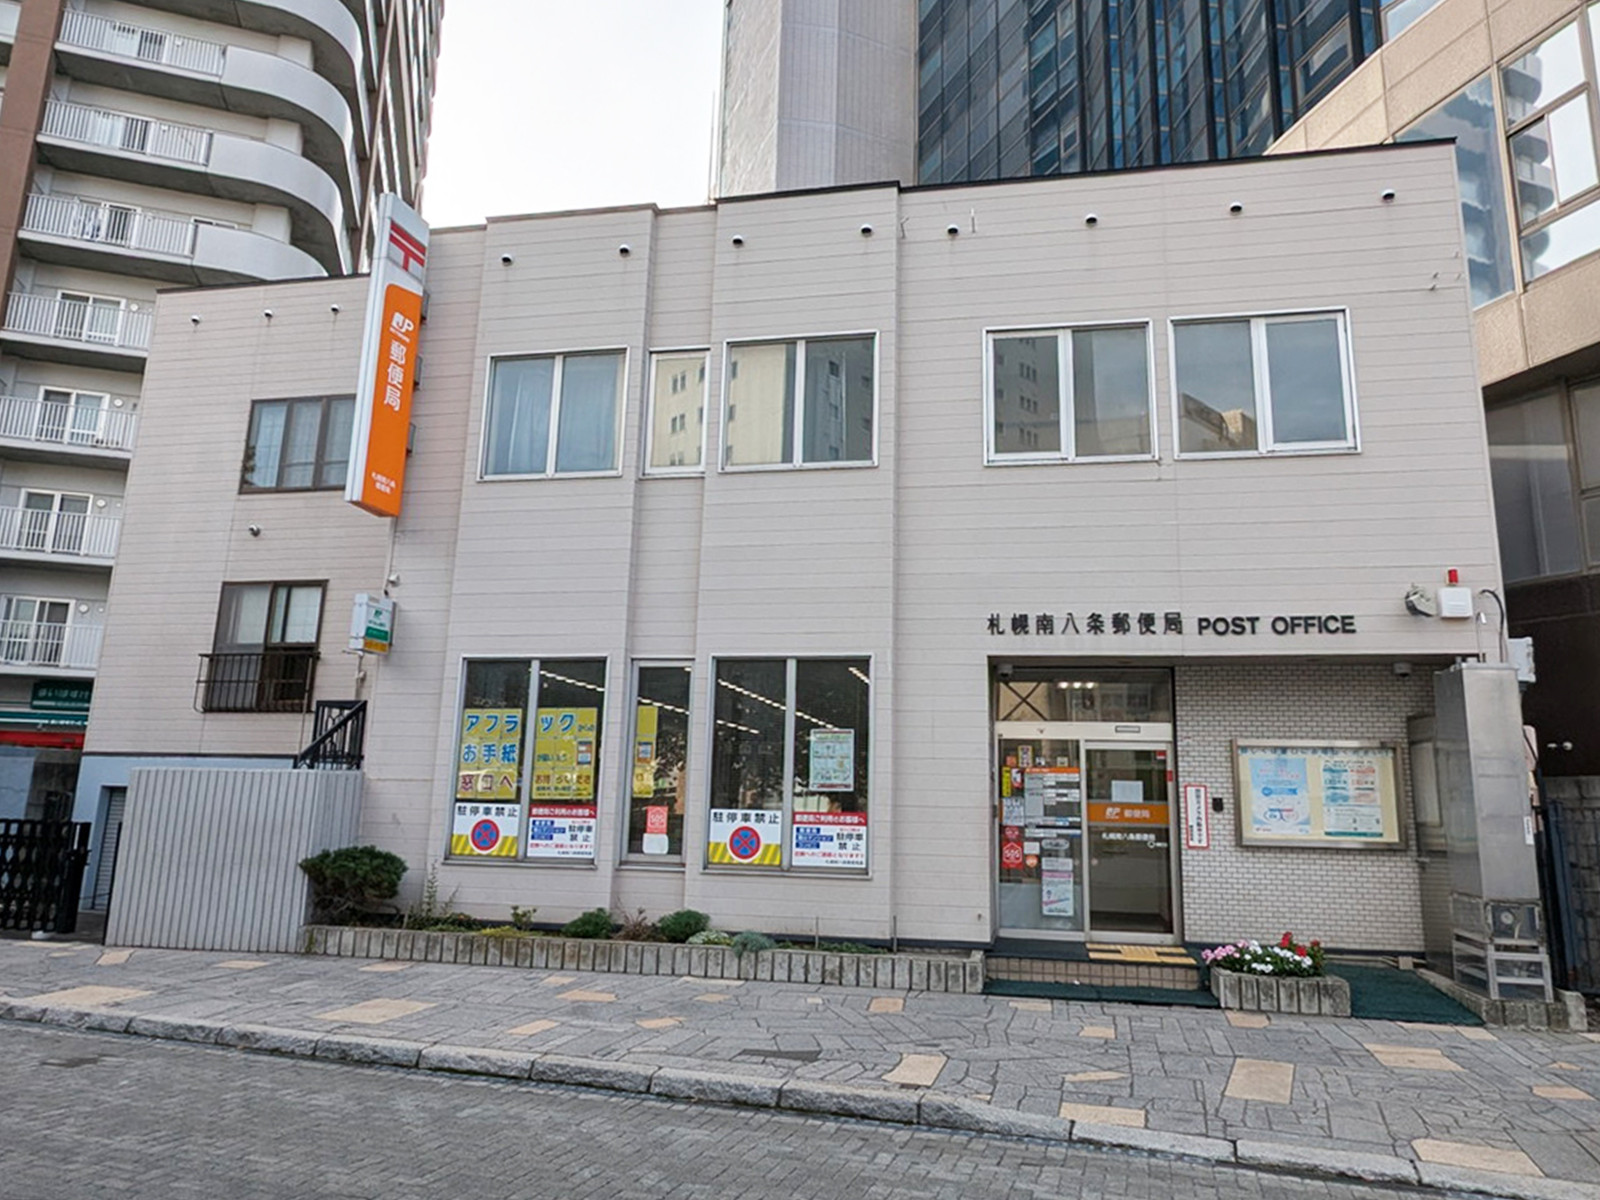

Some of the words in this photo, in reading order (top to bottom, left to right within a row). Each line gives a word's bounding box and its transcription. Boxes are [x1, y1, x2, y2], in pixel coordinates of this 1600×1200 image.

[384, 339, 407, 411] 郵便局
[986, 612, 1184, 636] 札幌南八条郵便局
[1197, 616, 1260, 636] POST
[1271, 615, 1357, 635] OFFICE
[463, 744, 517, 764] お手紙
[460, 773, 513, 792] 窓口へ
[457, 806, 518, 818] 駐停車禁止
[712, 811, 780, 824] 駐停車禁止
[568, 825, 593, 833] 駐停車
[836, 832, 864, 841] 駐停車
